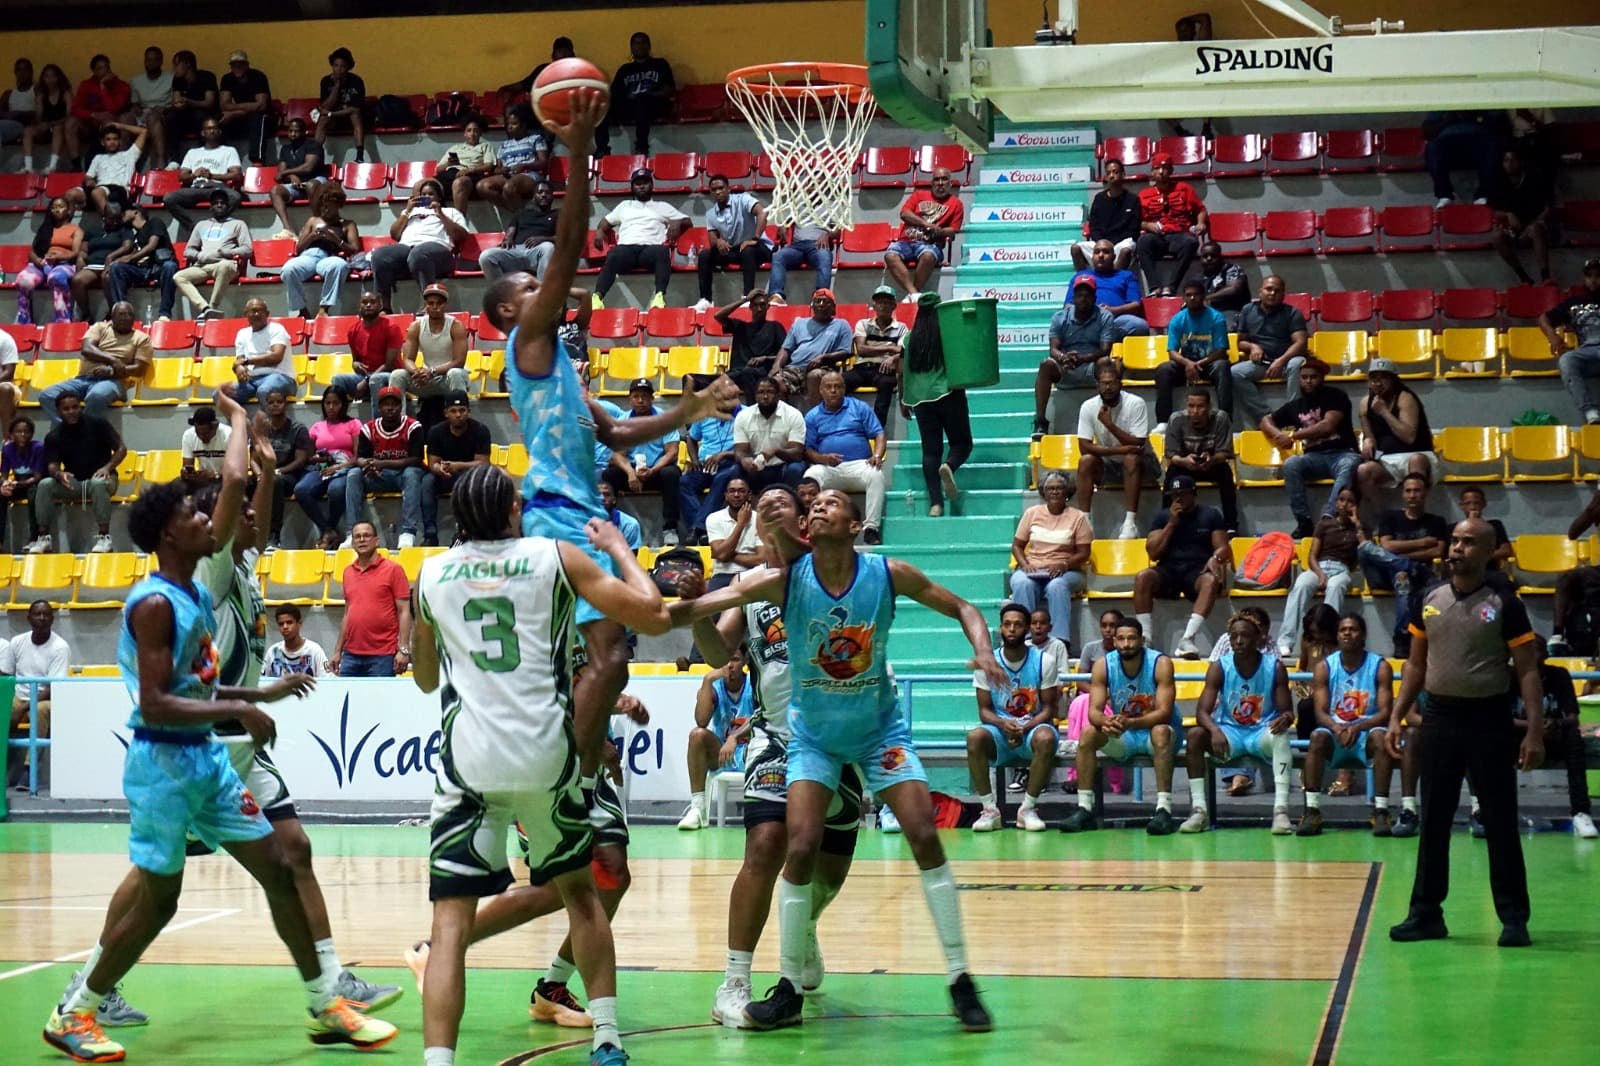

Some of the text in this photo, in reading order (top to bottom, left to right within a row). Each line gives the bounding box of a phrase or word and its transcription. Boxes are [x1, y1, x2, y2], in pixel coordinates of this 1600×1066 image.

[1196, 43, 1333, 75] SPALDING
[1018, 133, 1080, 146] Coors LIGHT
[1010, 170, 1073, 182] Coors LIGT
[1001, 208, 1066, 221] Coors LIGHT
[993, 248, 1060, 261] Coors LIGHT
[985, 288, 1053, 301] Coors LIGHT
[1013, 334, 1046, 343] LIGHT
[437, 558, 534, 584] ZAGLUL
[463, 596, 521, 673] 3
[374, 729, 442, 778] cae
[1279, 762, 1288, 776] 7
